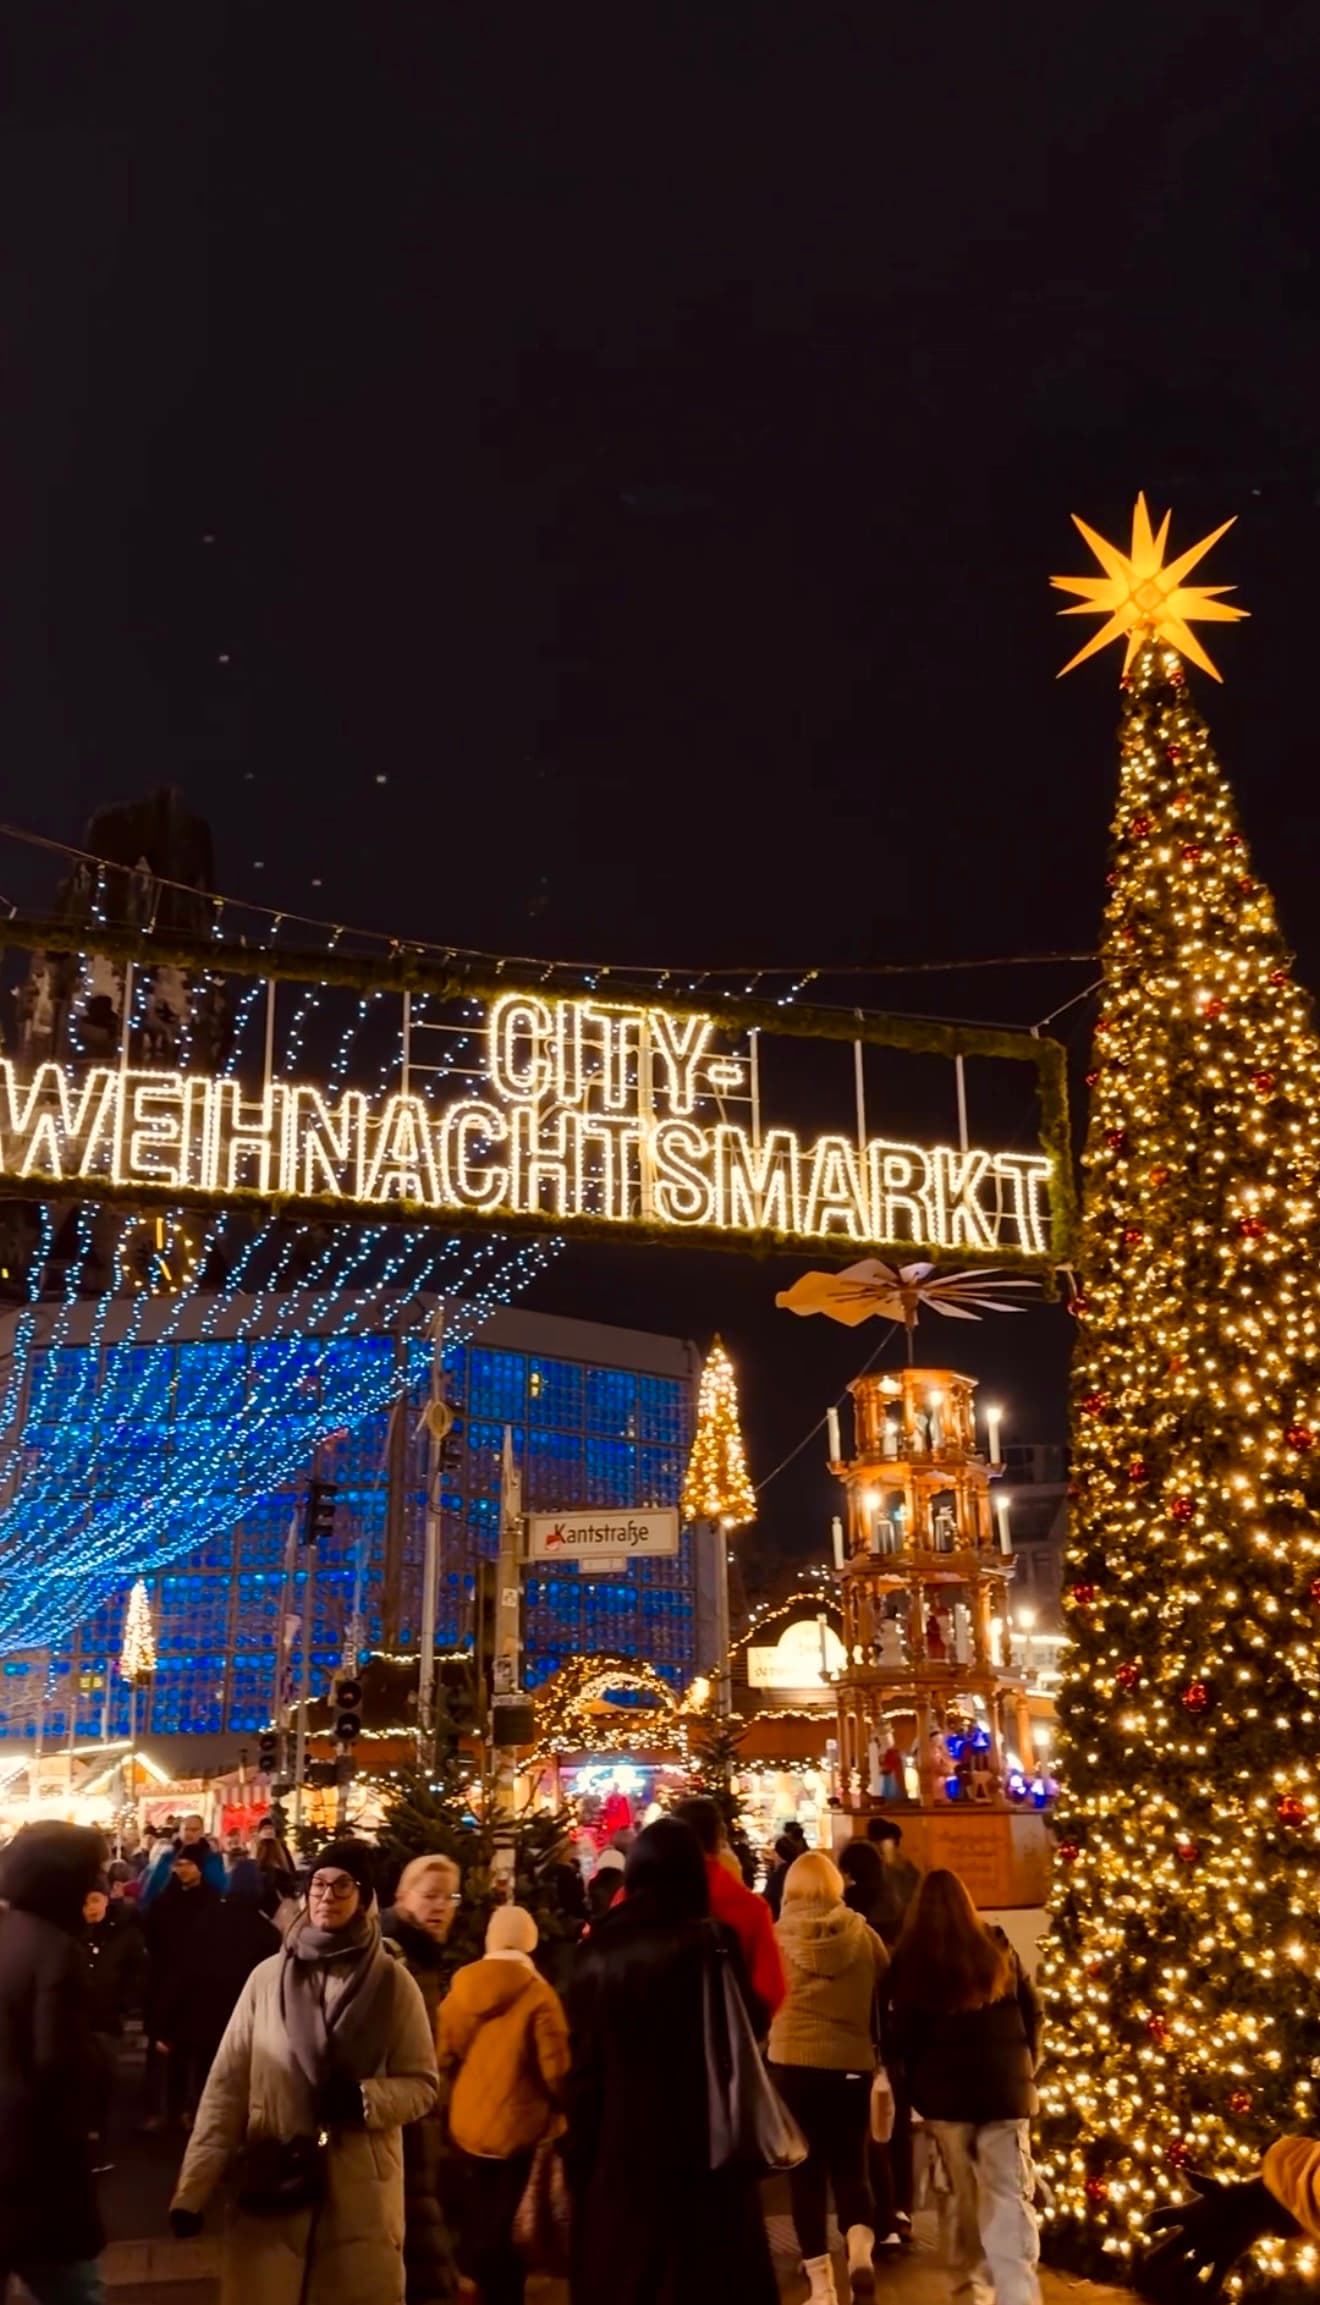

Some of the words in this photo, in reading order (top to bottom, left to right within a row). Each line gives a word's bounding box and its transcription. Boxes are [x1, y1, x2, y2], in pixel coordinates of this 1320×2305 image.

[488, 993, 744, 1115] CITY-
[0, 1058, 1055, 1256] WEIHNACHTSMARKT
[554, 1519, 650, 1547] Kantstraße
